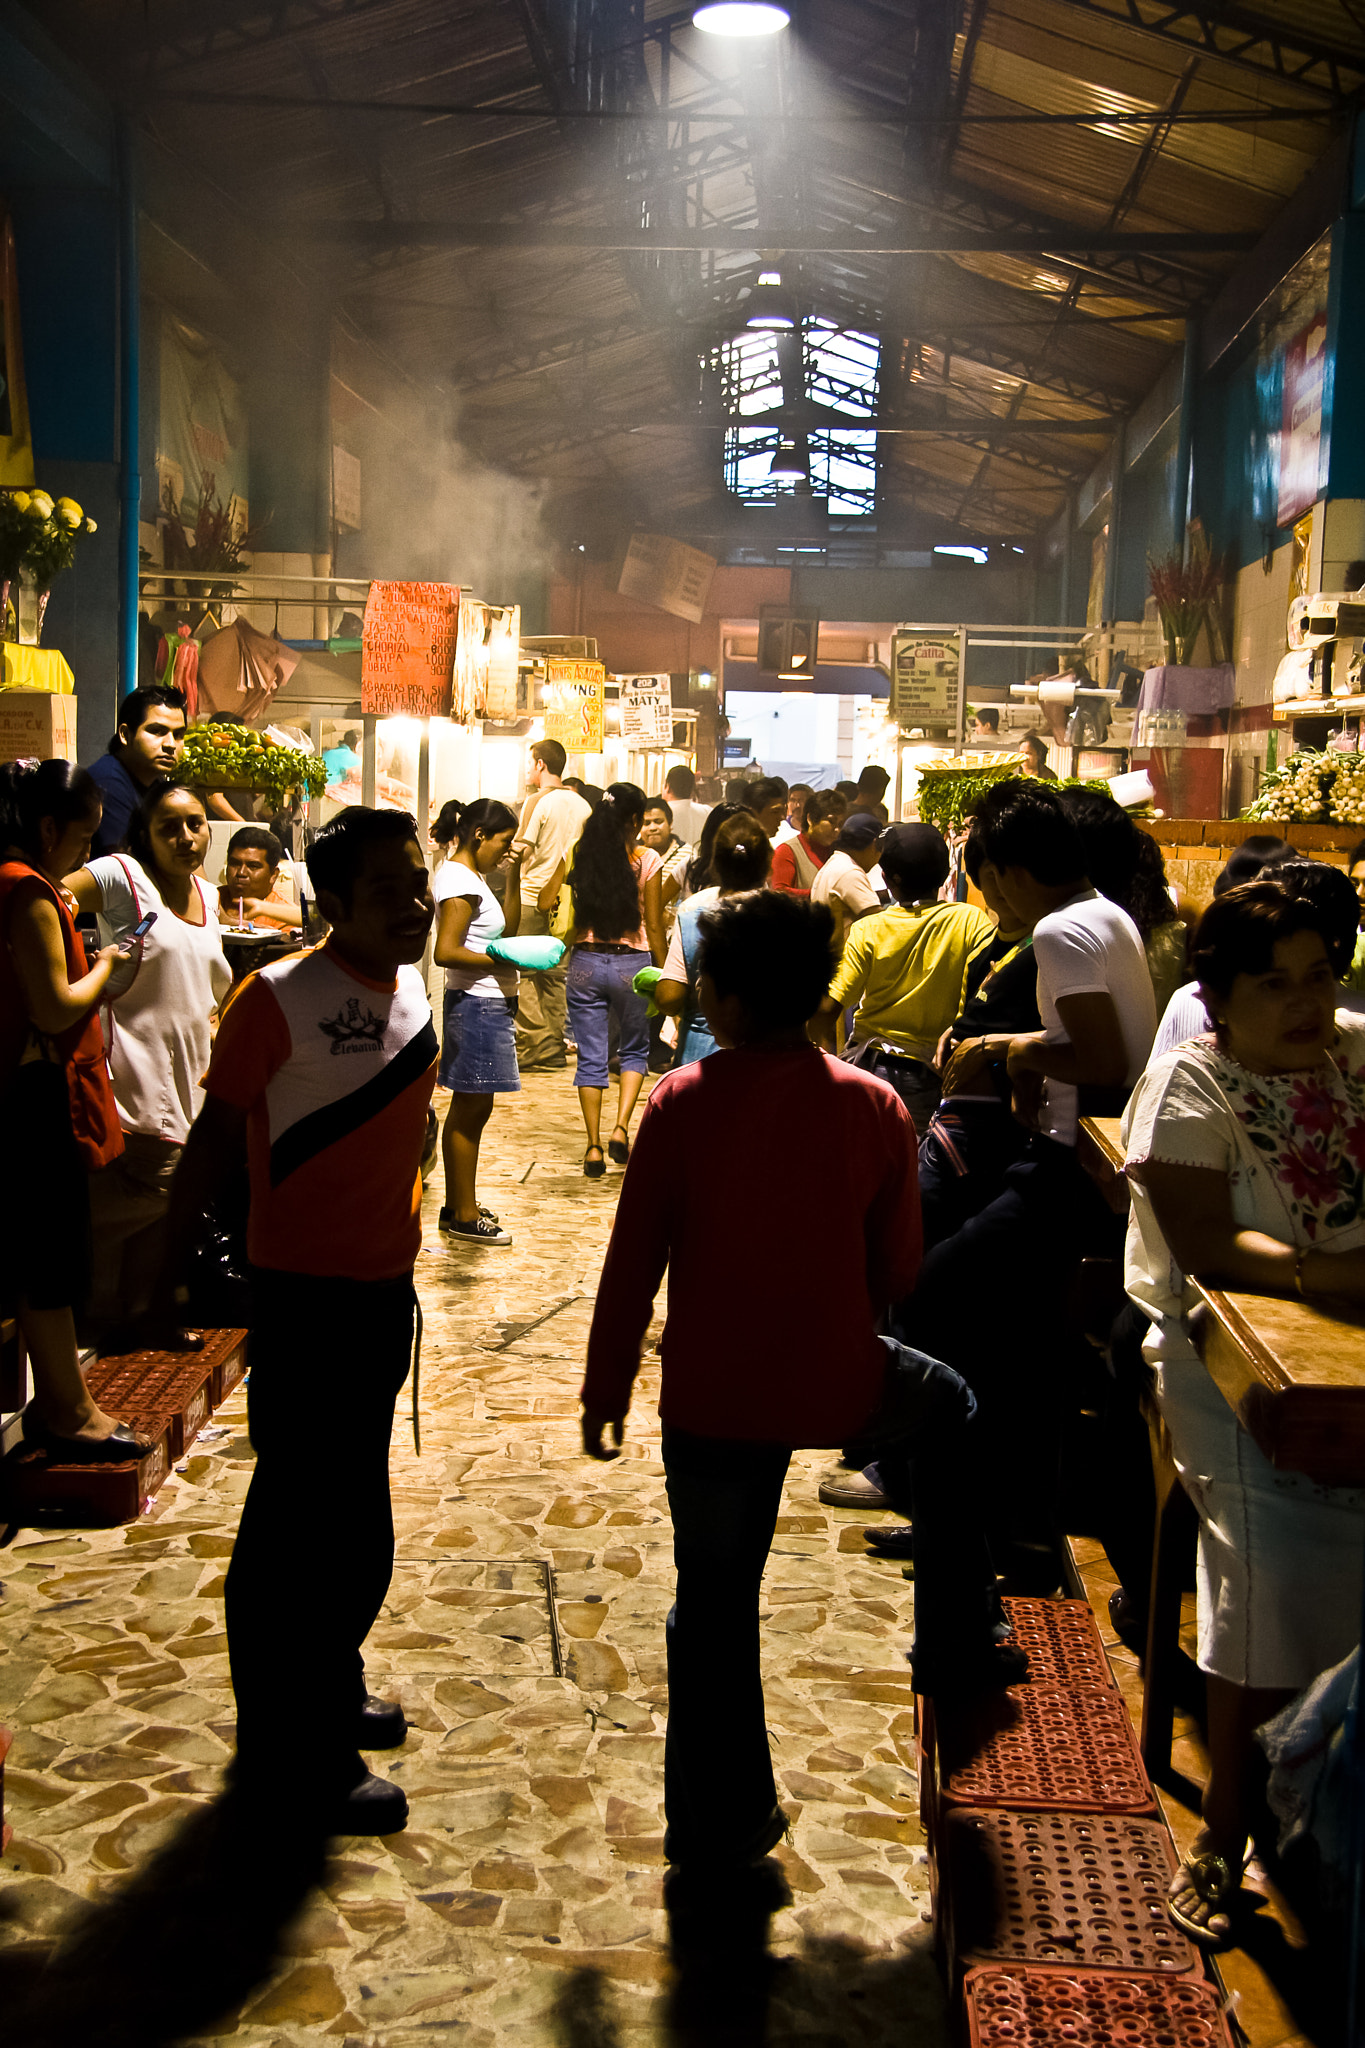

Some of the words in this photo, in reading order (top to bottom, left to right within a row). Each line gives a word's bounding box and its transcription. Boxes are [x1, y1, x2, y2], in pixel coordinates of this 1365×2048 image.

[414, 582, 452, 595] ASADAS
[375, 602, 387, 612] LE
[379, 613, 391, 623] DE
[406, 613, 452, 626] CALIDAD
[368, 620, 405, 634] TASAJO
[366, 632, 407, 644] CECINA
[367, 641, 410, 654] CHORIZO
[914, 648, 945, 659] Catita
[368, 652, 404, 664] TRIPA
[367, 662, 393, 674] UBRE
[574, 663, 602, 686] ASADAS
[636, 679, 653, 689] 202
[407, 684, 424, 694] POR
[431, 685, 444, 697] SU
[629, 696, 661, 706] MATY
[367, 701, 394, 714] BUEN
